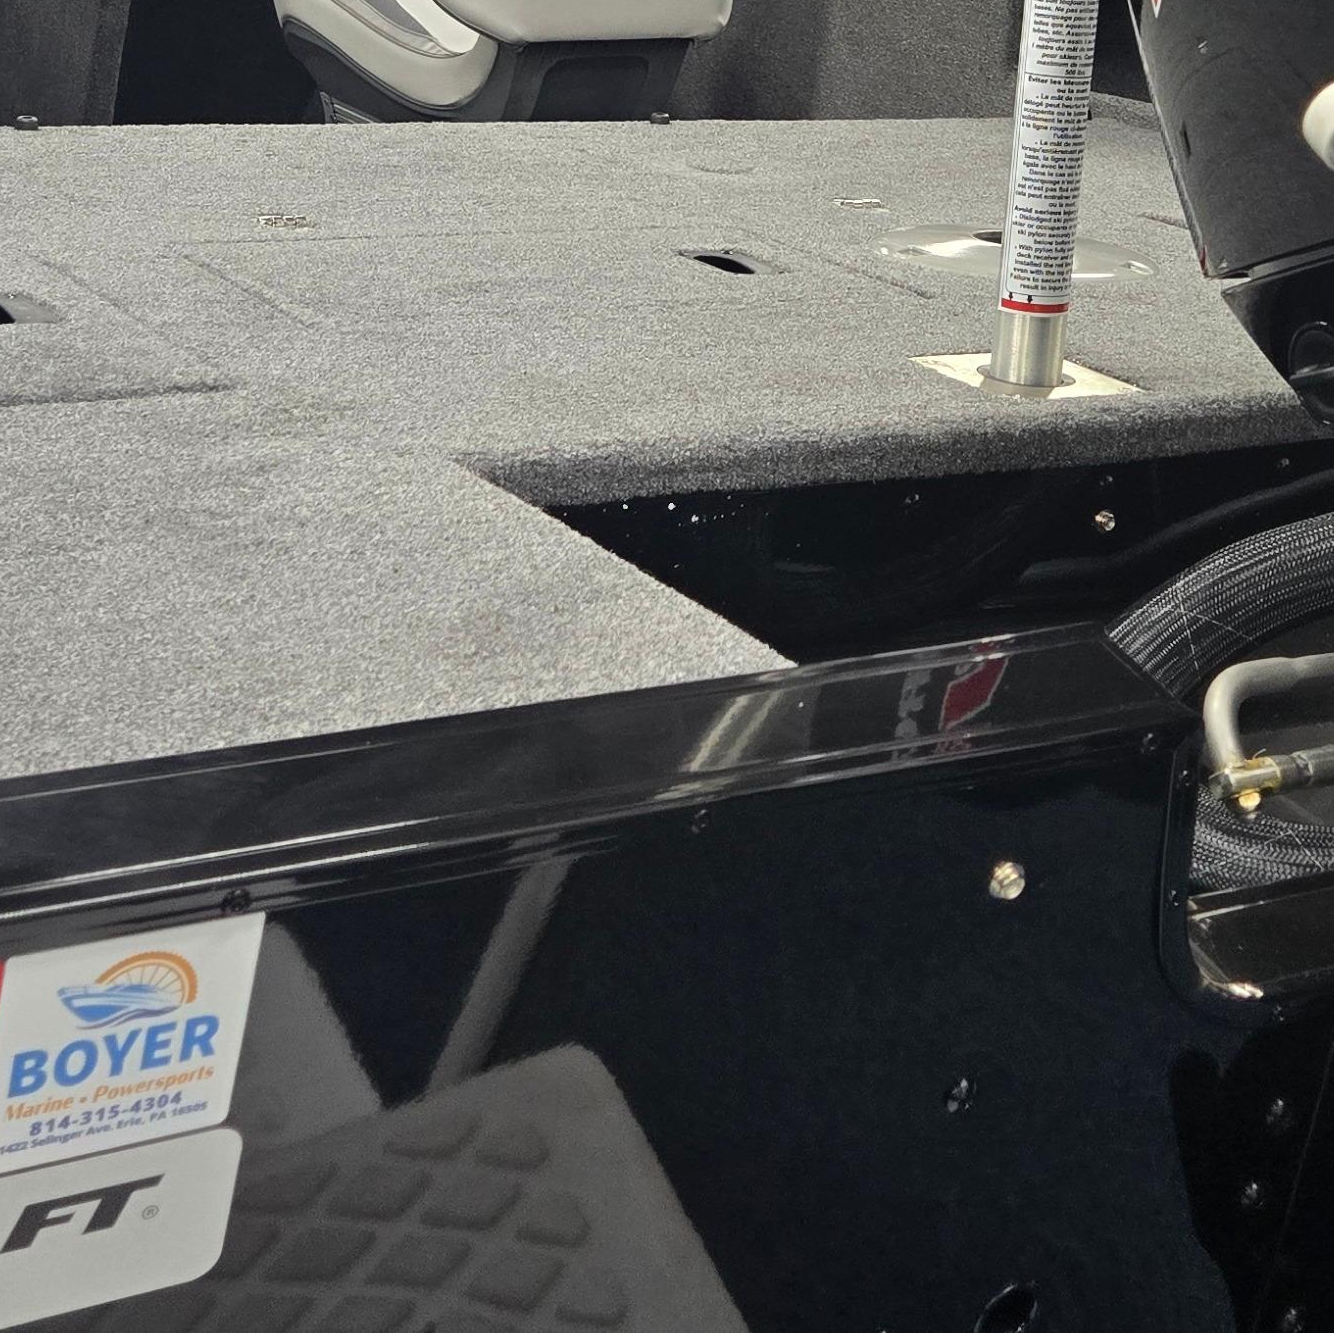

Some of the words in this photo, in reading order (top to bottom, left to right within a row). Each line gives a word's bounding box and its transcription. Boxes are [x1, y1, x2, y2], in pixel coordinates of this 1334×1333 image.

[7, 1014, 220, 1098] BOYER
[4, 1096, 75, 1122] Marine
[92, 1066, 215, 1103] Powersports
[29, 1091, 182, 1137] 814-315-4304
